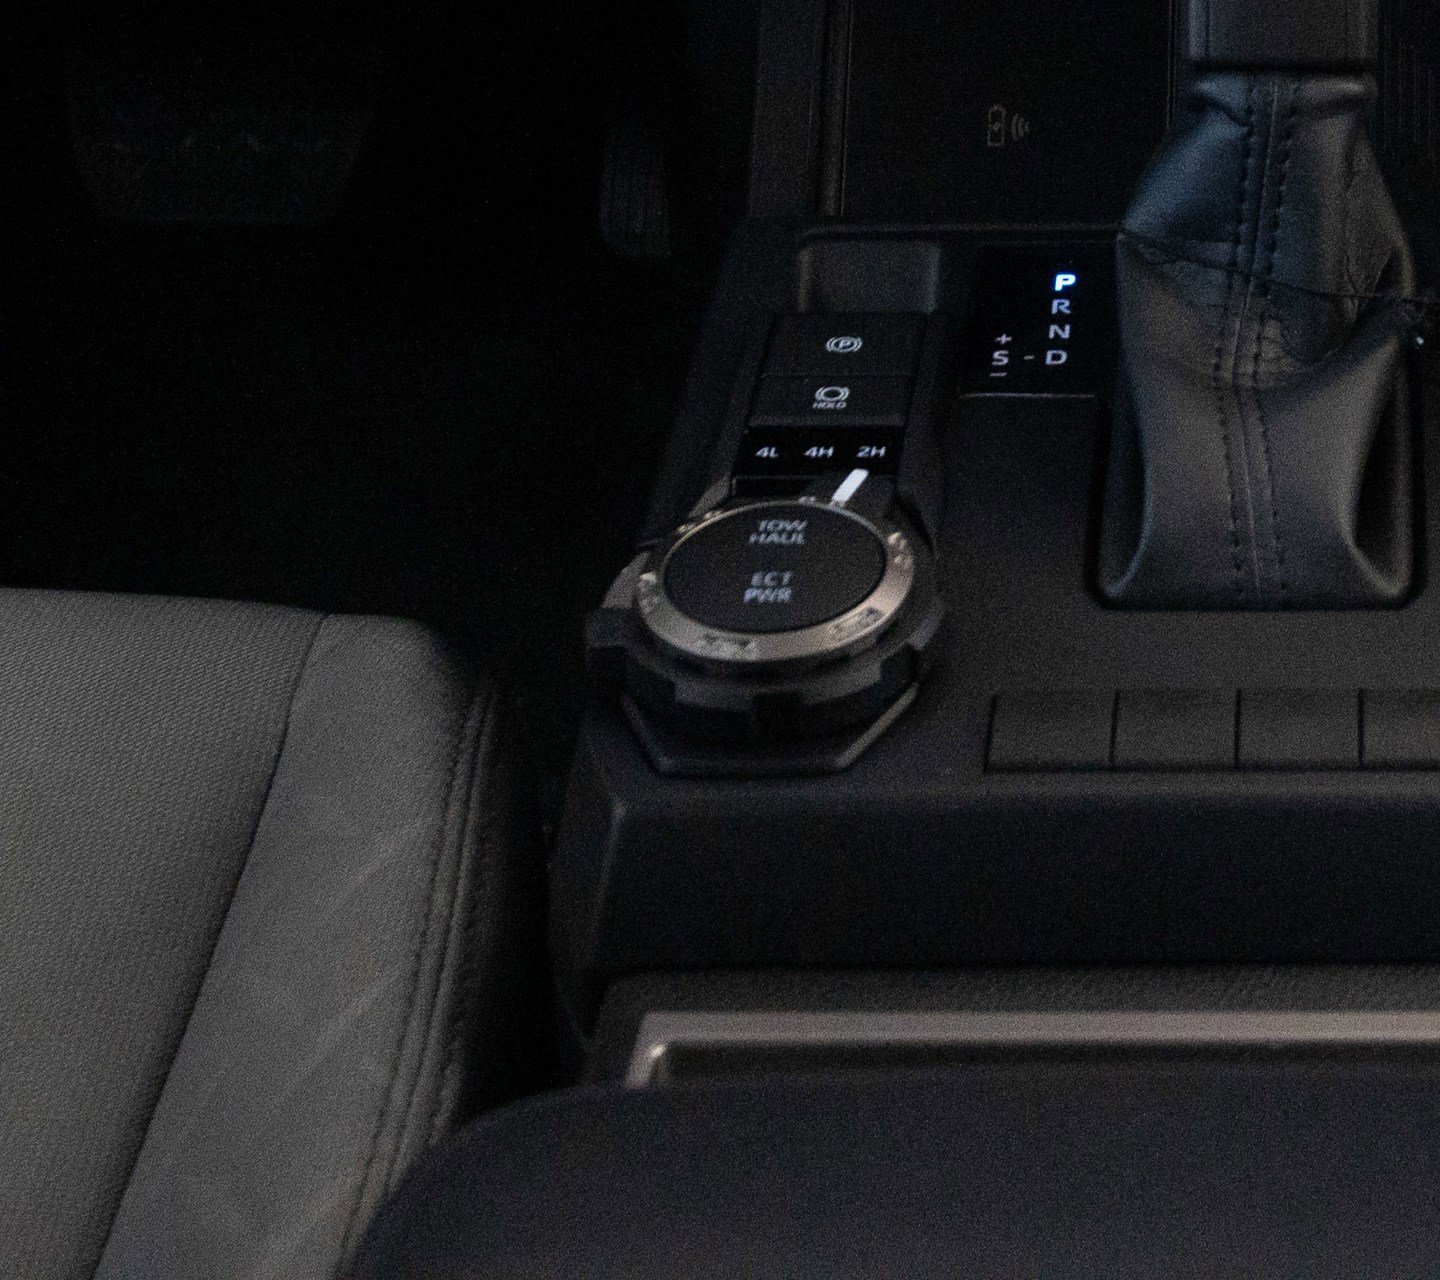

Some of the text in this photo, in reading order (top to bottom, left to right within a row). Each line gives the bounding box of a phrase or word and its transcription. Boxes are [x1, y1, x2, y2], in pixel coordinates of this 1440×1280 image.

[1053, 273, 1076, 291] P
[1051, 298, 1071, 315] R
[1048, 323, 1071, 340] N
[991, 349, 1068, 366] S D
[754, 445, 887, 458] 4L 4H 2H
